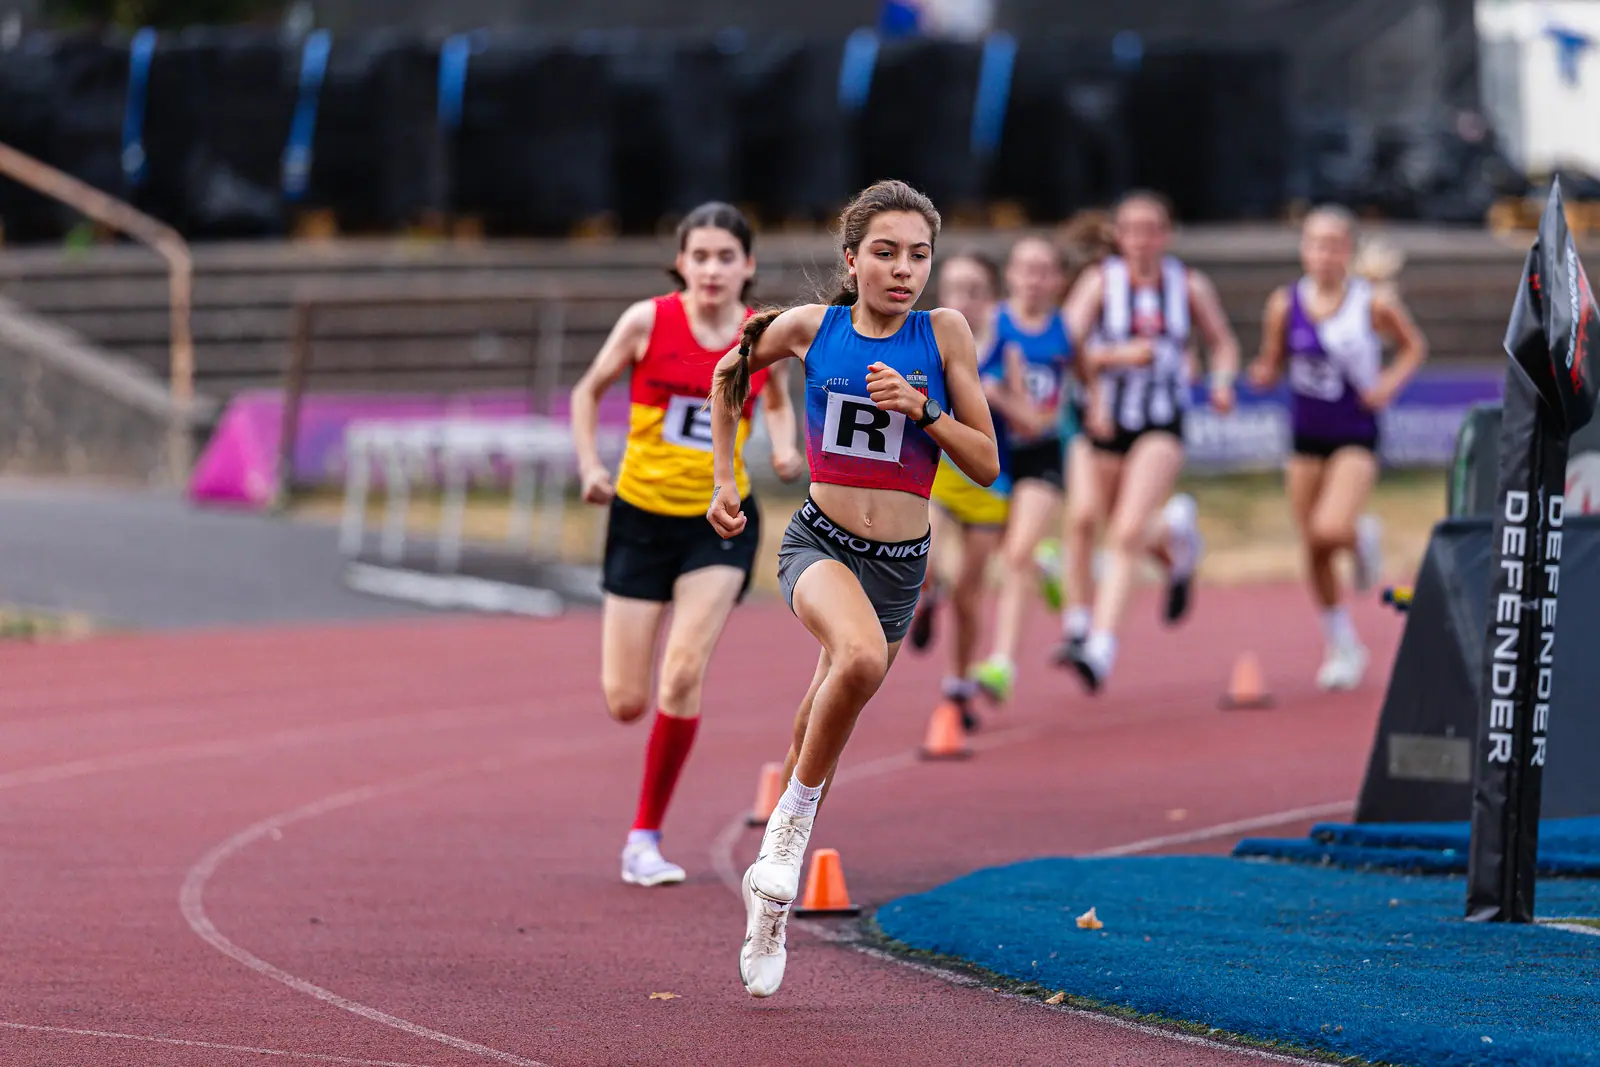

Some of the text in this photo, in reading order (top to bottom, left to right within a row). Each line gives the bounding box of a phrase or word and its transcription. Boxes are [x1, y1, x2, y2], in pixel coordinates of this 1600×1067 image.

[836, 400, 891, 453] R
[812, 515, 871, 552] PRO
[875, 536, 931, 558] NIKE
[1488, 490, 1529, 763] DEFENDER
[1530, 495, 1564, 767] DEFENDER
